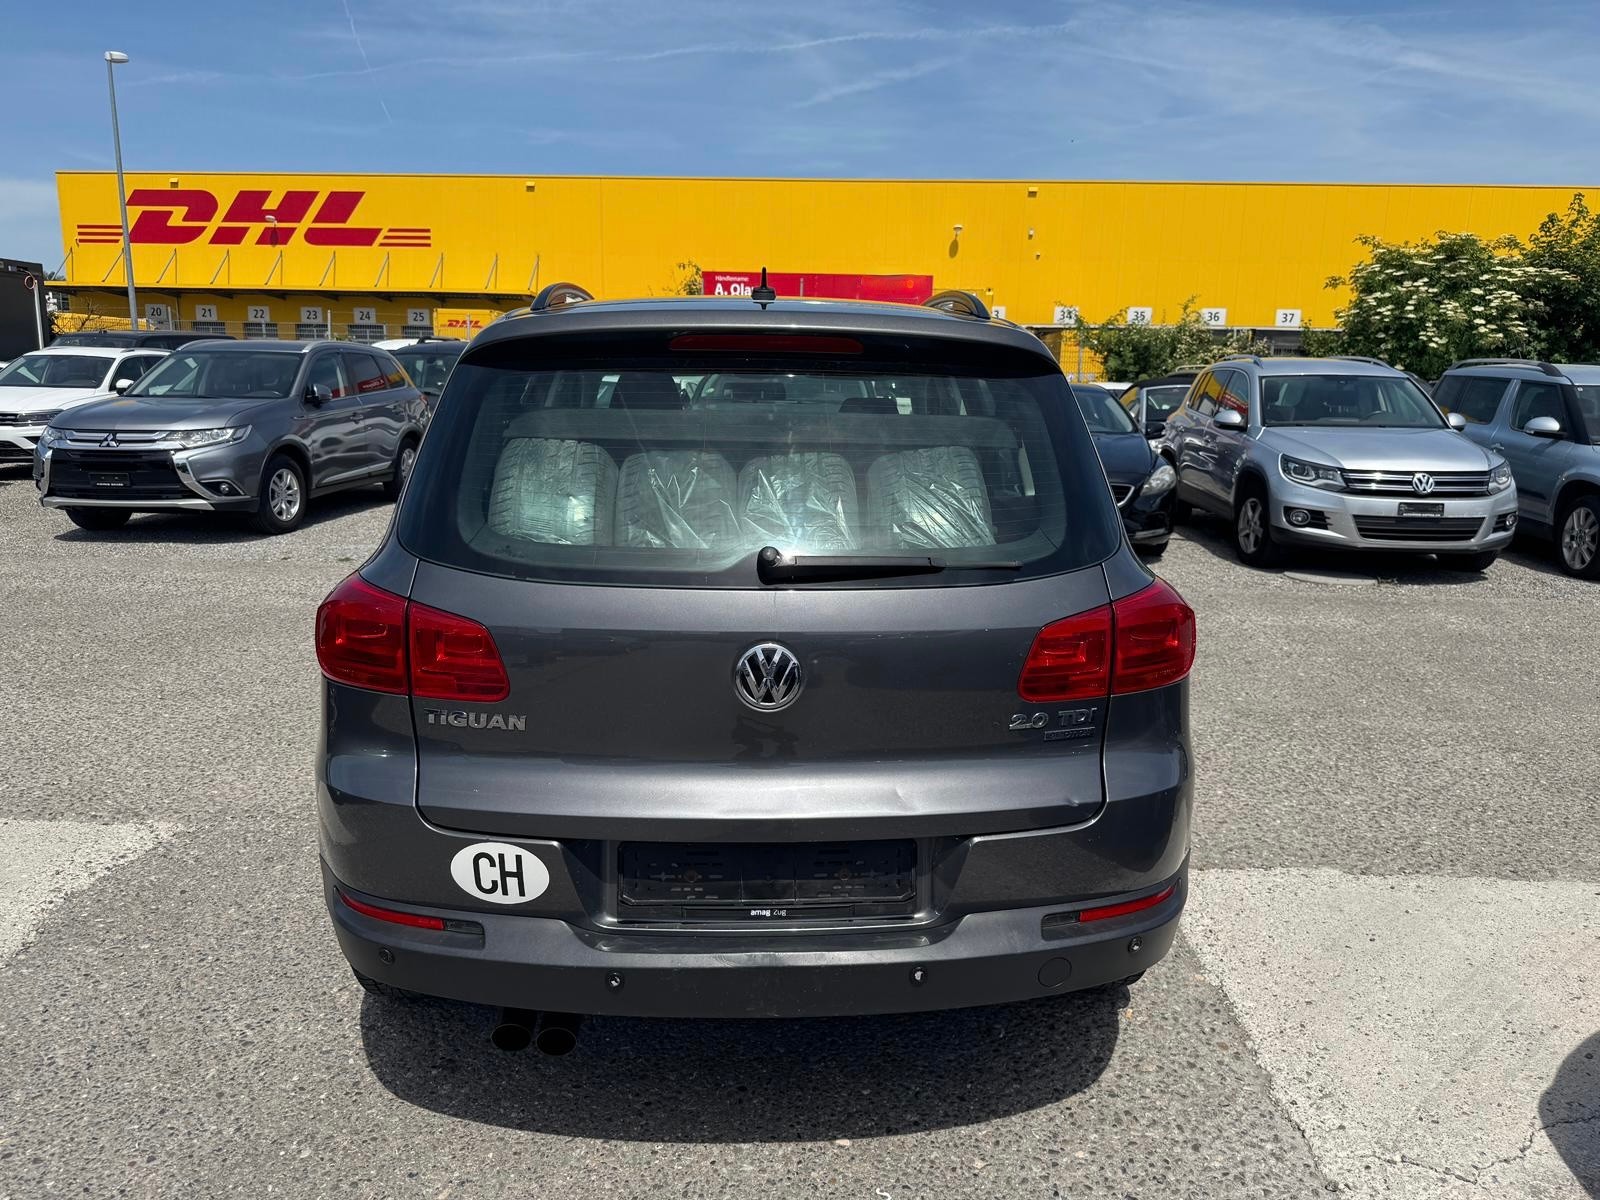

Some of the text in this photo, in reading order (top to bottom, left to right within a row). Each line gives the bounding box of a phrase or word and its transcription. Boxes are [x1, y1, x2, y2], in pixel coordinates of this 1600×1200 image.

[125, 189, 384, 247] DHL
[714, 282, 754, 296] A. Ola
[150, 307, 162, 317] 20
[201, 308, 212, 318] 21
[253, 309, 265, 319] 22
[306, 310, 318, 320] 23
[359, 311, 371, 321] 24
[413, 312, 425, 322] 25
[1133, 311, 1146, 321] 35
[1207, 312, 1220, 322] 36
[1281, 313, 1295, 323] 37
[447, 319, 484, 328] DHL
[737, 644, 801, 711] VW
[1009, 711, 1049, 730] 2.0
[472, 852, 526, 897] CH
[750, 909, 771, 917] amag
